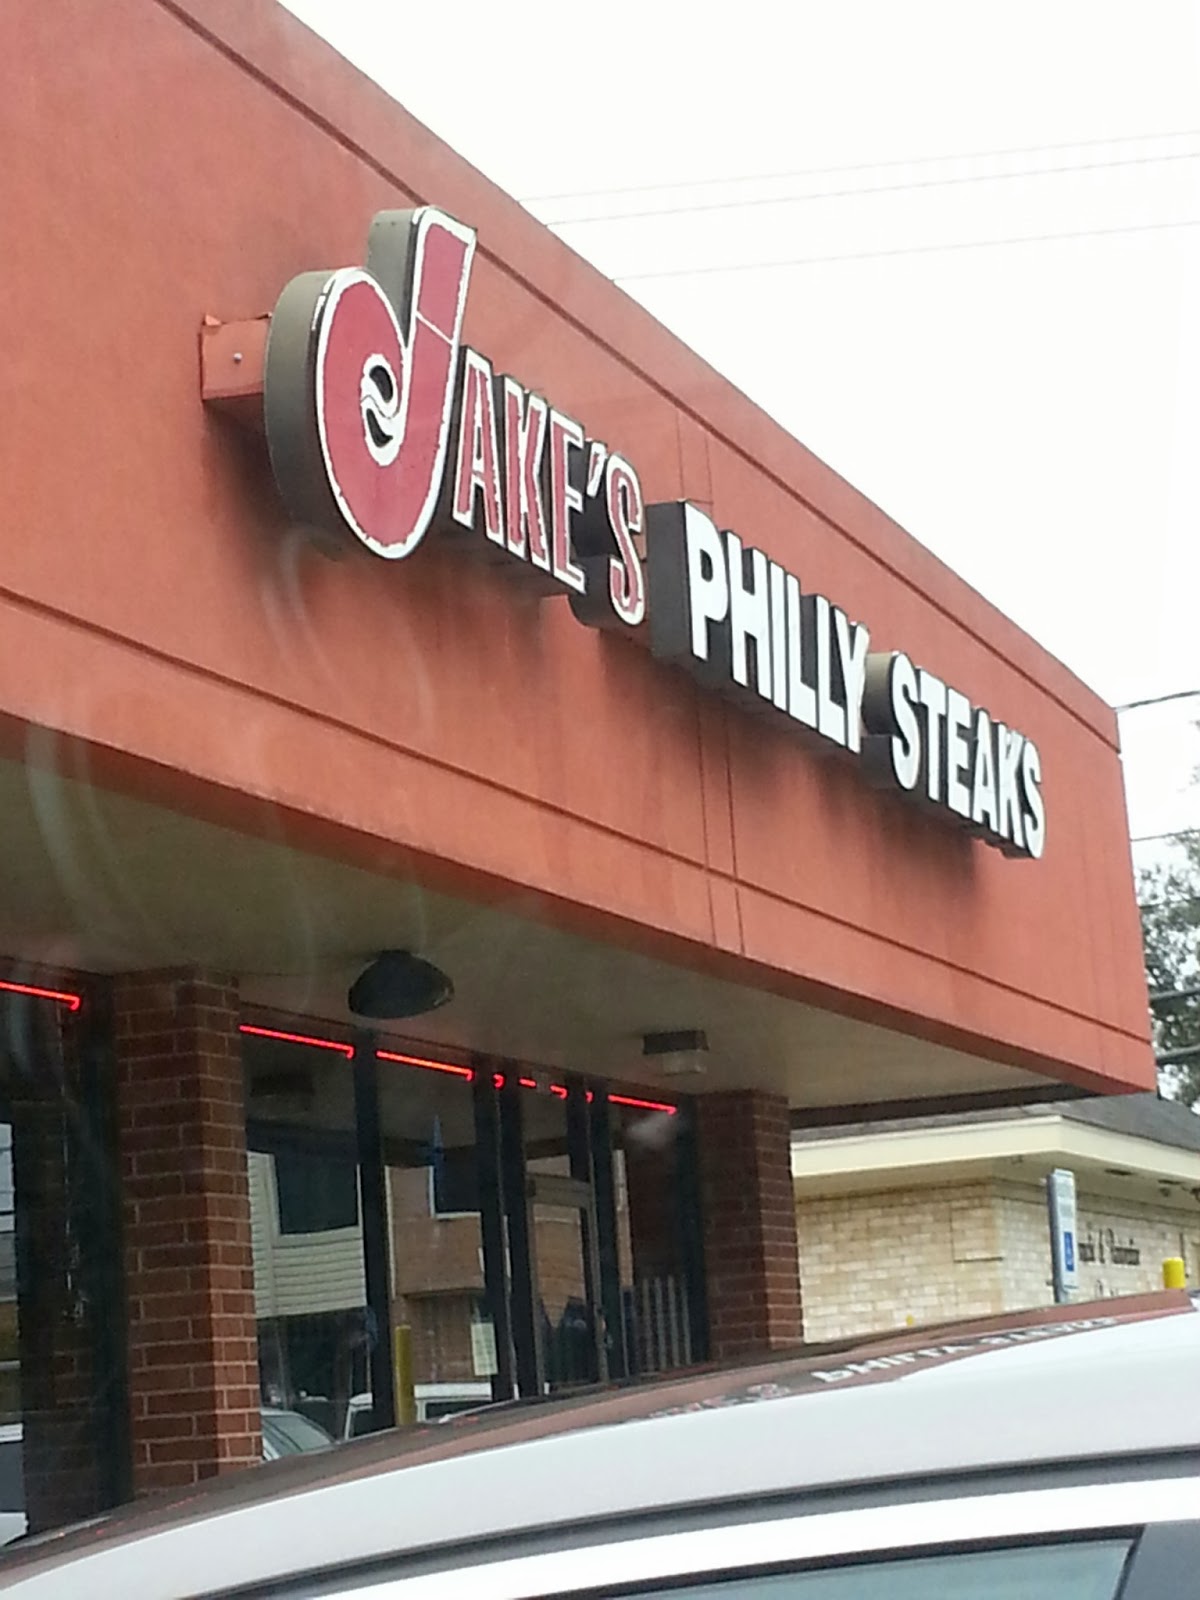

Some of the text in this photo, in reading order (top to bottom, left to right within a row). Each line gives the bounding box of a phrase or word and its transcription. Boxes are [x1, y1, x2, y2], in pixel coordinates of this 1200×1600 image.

[313, 206, 1046, 859] JAKE'S PHILLY STEAKS
